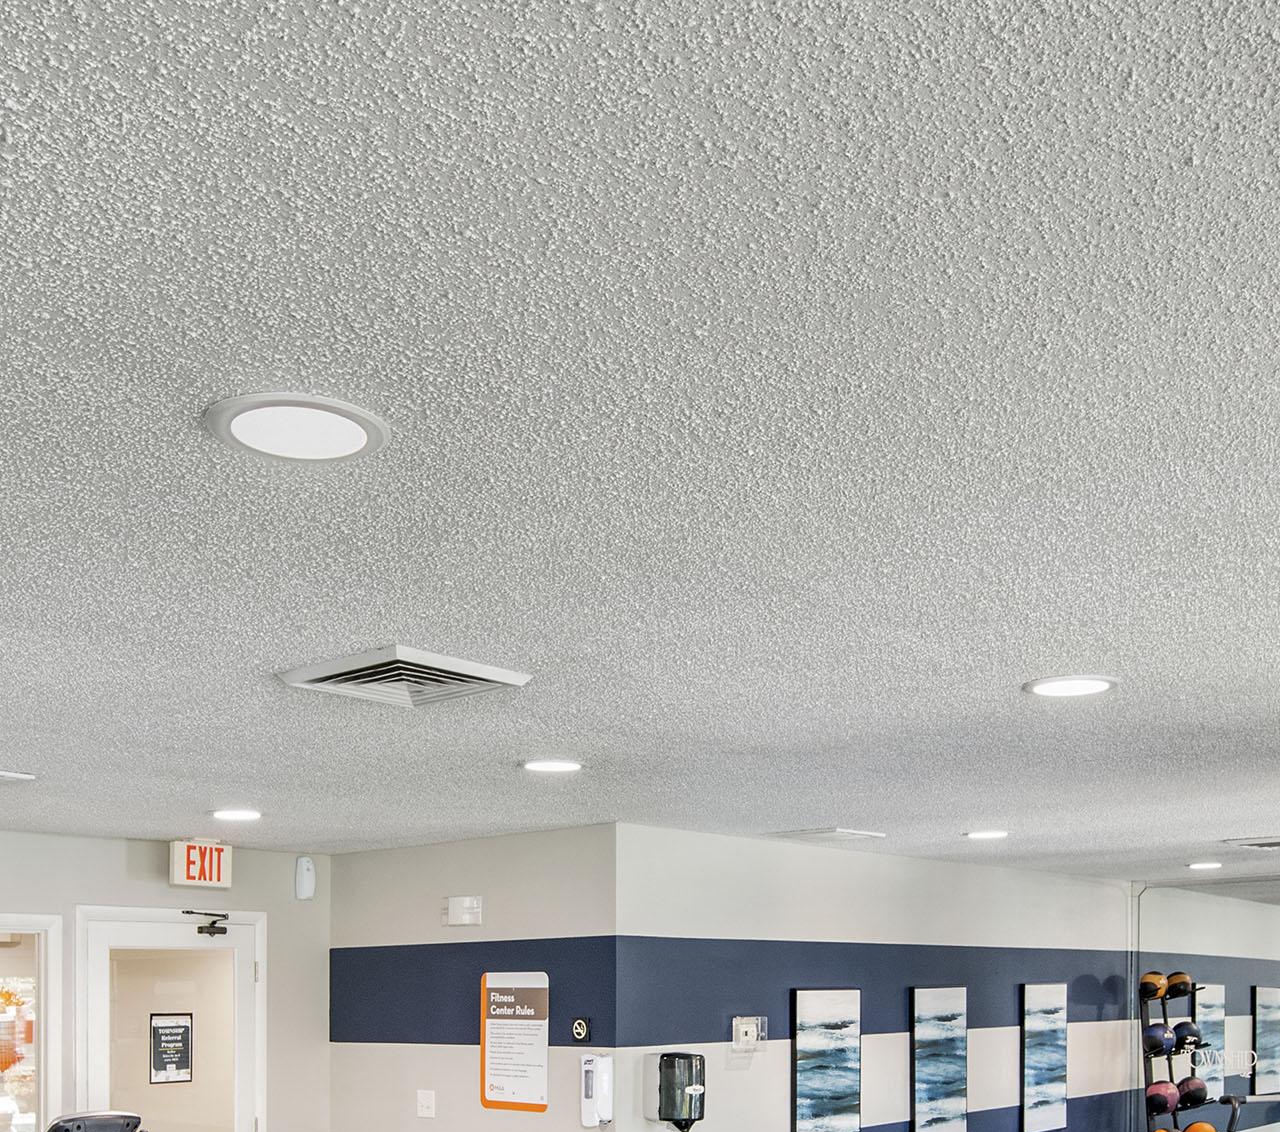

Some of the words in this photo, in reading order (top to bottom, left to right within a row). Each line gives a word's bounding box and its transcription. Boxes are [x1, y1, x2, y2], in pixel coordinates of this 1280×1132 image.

[185, 844, 224, 882] EXIT
[490, 992, 515, 1002] Fitness
[490, 1005, 514, 1015] Center
[515, 1005, 535, 1016] Rules
